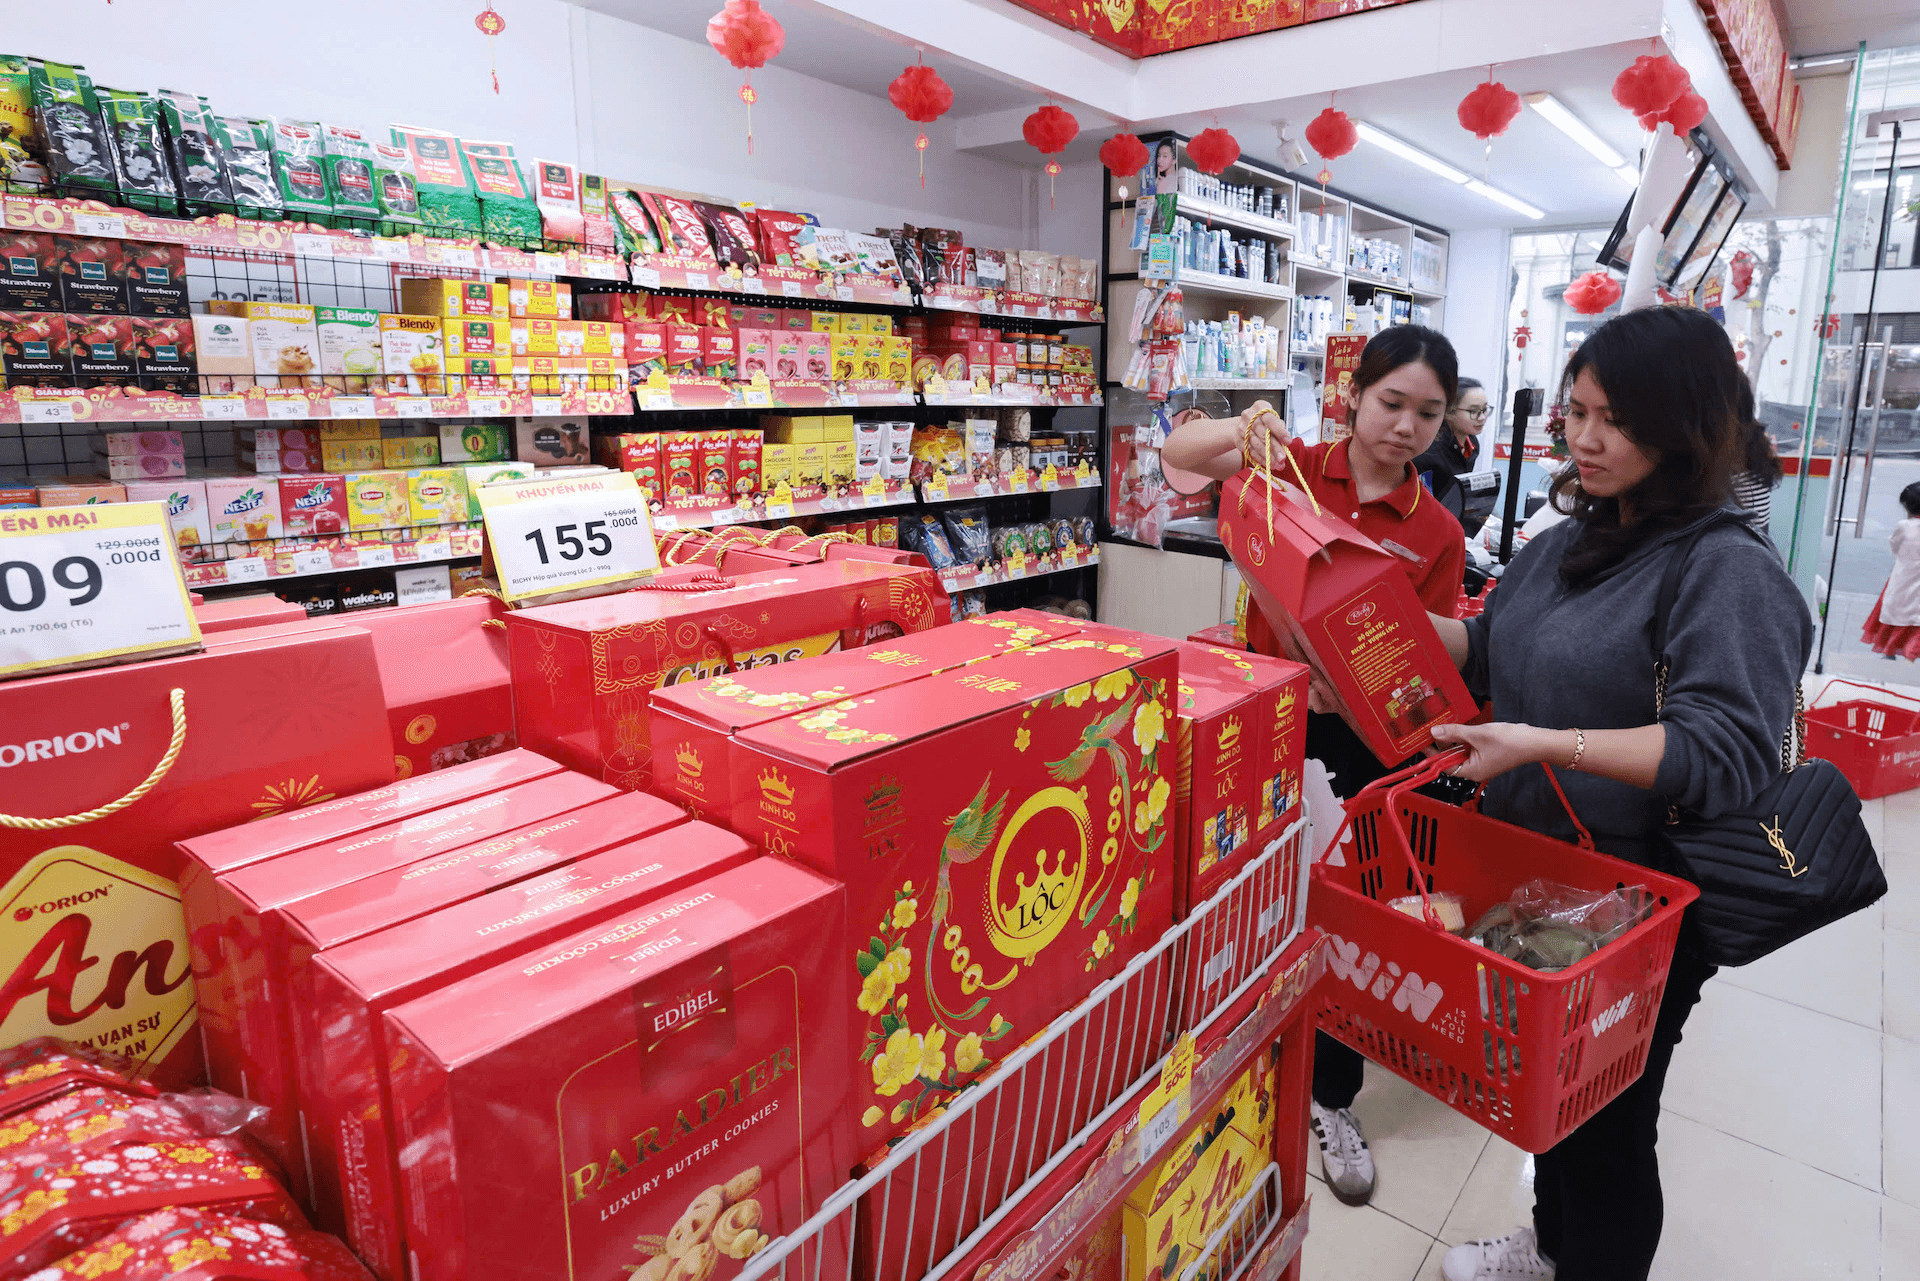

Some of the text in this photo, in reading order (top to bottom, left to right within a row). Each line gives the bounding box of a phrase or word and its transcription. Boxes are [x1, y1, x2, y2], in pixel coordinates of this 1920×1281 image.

[98, 222, 112, 231] 37
[0, 278, 52, 289] Strawberry
[70, 282, 120, 292] Strawberry
[135, 286, 182, 297] Strawberry
[269, 305, 312, 320] Blendy
[336, 310, 377, 322] Blendy
[399, 318, 435, 329] Blendy
[12, 362, 64, 371] Strawberry
[82, 363, 130, 372] Strawberry
[145, 365, 190, 373] Strawberry
[45, 408, 60, 416] 43
[413, 405, 423, 413] 28
[421, 487, 443, 496] Lipton
[516, 481, 604, 501] KHUYẾN MẠI
[224, 501, 265, 515] NESTEA
[295, 494, 333, 509] NESTEA
[47, 512, 98, 529] MẠI
[604, 508, 637, 518] 165.000đ
[609, 517, 639, 529] .000đ
[96, 538, 160, 550] 129.000đ
[524, 520, 613, 565] 155
[105, 549, 161, 566] .000đ
[310, 557, 322, 565] 42
[512, 576, 532, 585] RICHY
[533, 573, 546, 583] Hộp
[547, 572, 558, 582] quà
[558, 569, 577, 580] Vương
[577, 566, 588, 576] Lộc
[342, 591, 395, 606] wake-up
[10, 618, 94, 636] An 700,6g (T6)
[1357, 620, 1386, 642] BỘ QUÀ TẾT
[1350, 643, 1367, 656] RICHY
[1273, 713, 1296, 733] KINH DO
[1216, 744, 1242, 766] KINH DO
[1273, 737, 1292, 764] LỘC
[676, 772, 705, 793] KINH DO
[1216, 771, 1240, 801] LỘC
[759, 798, 797, 824] KINH DO
[529, 818, 580, 841] LUXURY
[763, 828, 796, 860] LỘC
[401, 854, 476, 881] COOKIES
[490, 849, 544, 872] EDIBEL
[525, 873, 581, 897] EDIBEL
[475, 908, 541, 937] LUXURY
[598, 862, 663, 890] COOKIES
[1017, 882, 1065, 932] LỘC
[522, 892, 716, 977] LUXURY BUTTER COOKIES
[623, 932, 682, 965] EDIBEL
[0, 912, 192, 1027] An
[653, 989, 719, 1033] EDIBEL
[1445, 1012, 1466, 1029] ALL
[1455, 1006, 1467, 1019] IS
[1431, 1022, 1465, 1045] NEED
[1440, 1017, 1465, 1037] YOU
[1164, 1064, 1187, 1095] SỐC
[569, 1046, 796, 1207] PARADIER
[1153, 1117, 1171, 1140] 105
[600, 1099, 780, 1222] LUXURY BUTTER COOKIES
